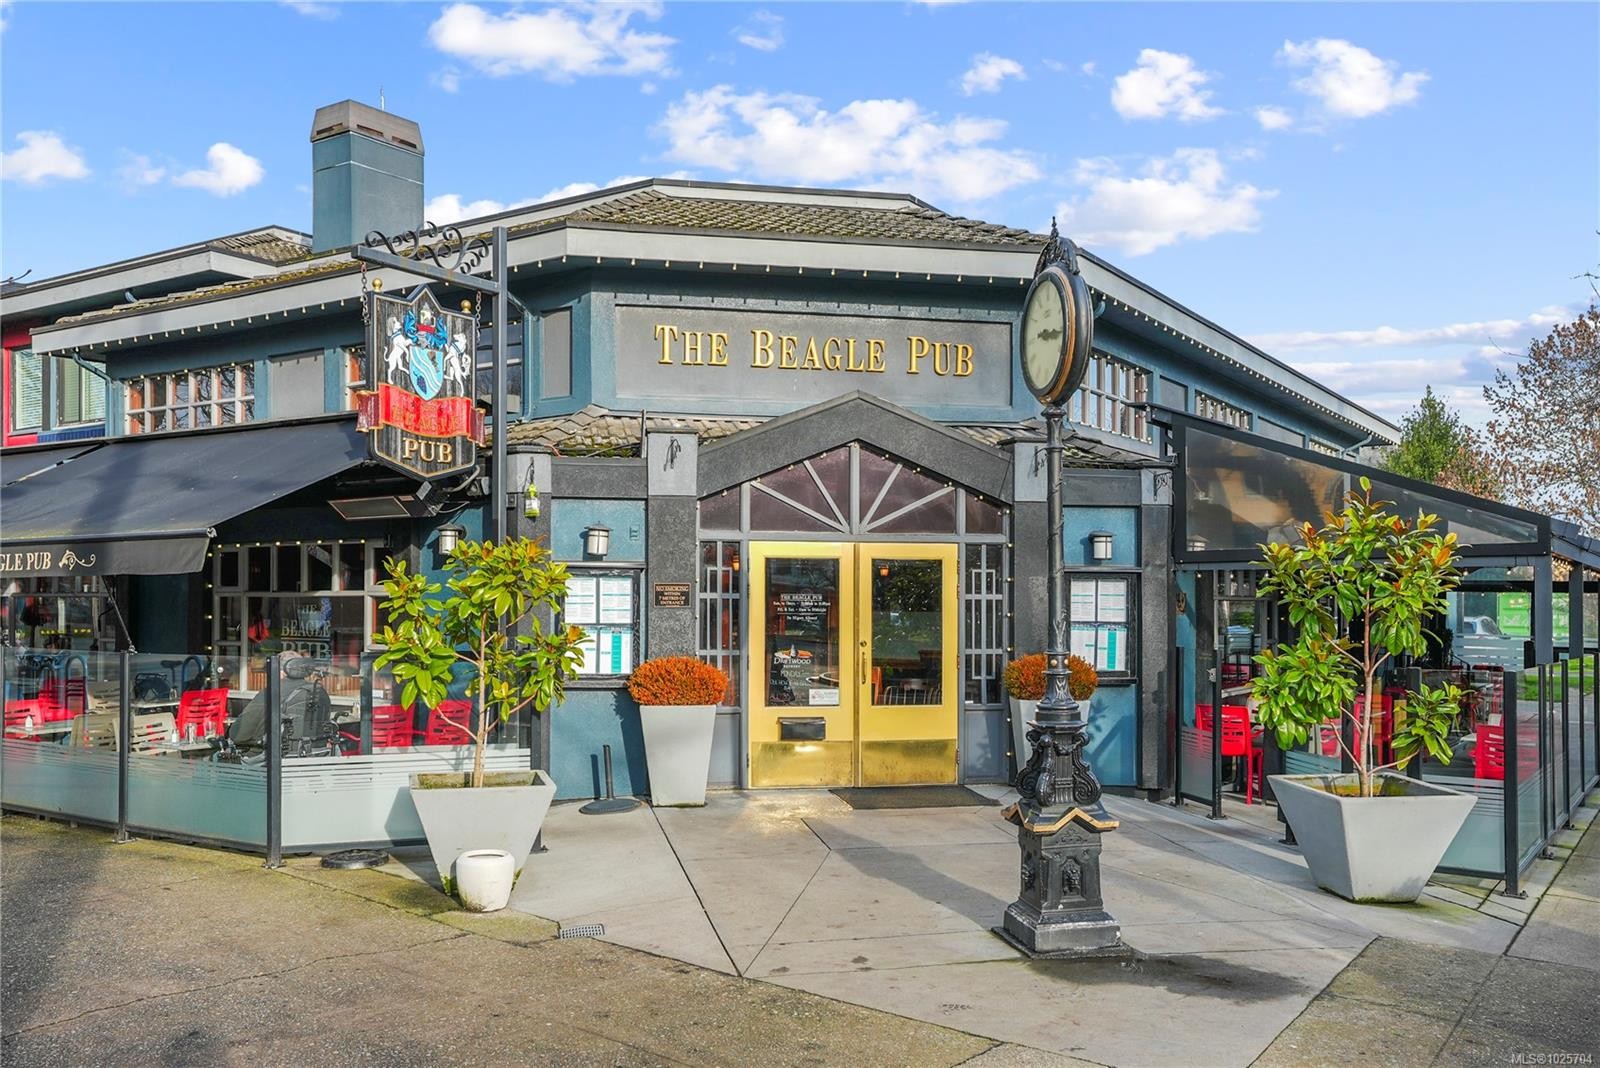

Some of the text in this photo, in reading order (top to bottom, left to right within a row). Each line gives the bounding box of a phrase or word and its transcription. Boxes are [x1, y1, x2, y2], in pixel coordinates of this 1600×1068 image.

[654, 323, 974, 377] THE BEAGLE PUB
[402, 437, 452, 463] PUB
[26, 551, 51, 570] PUB
[280, 619, 331, 638] BEAGLE
